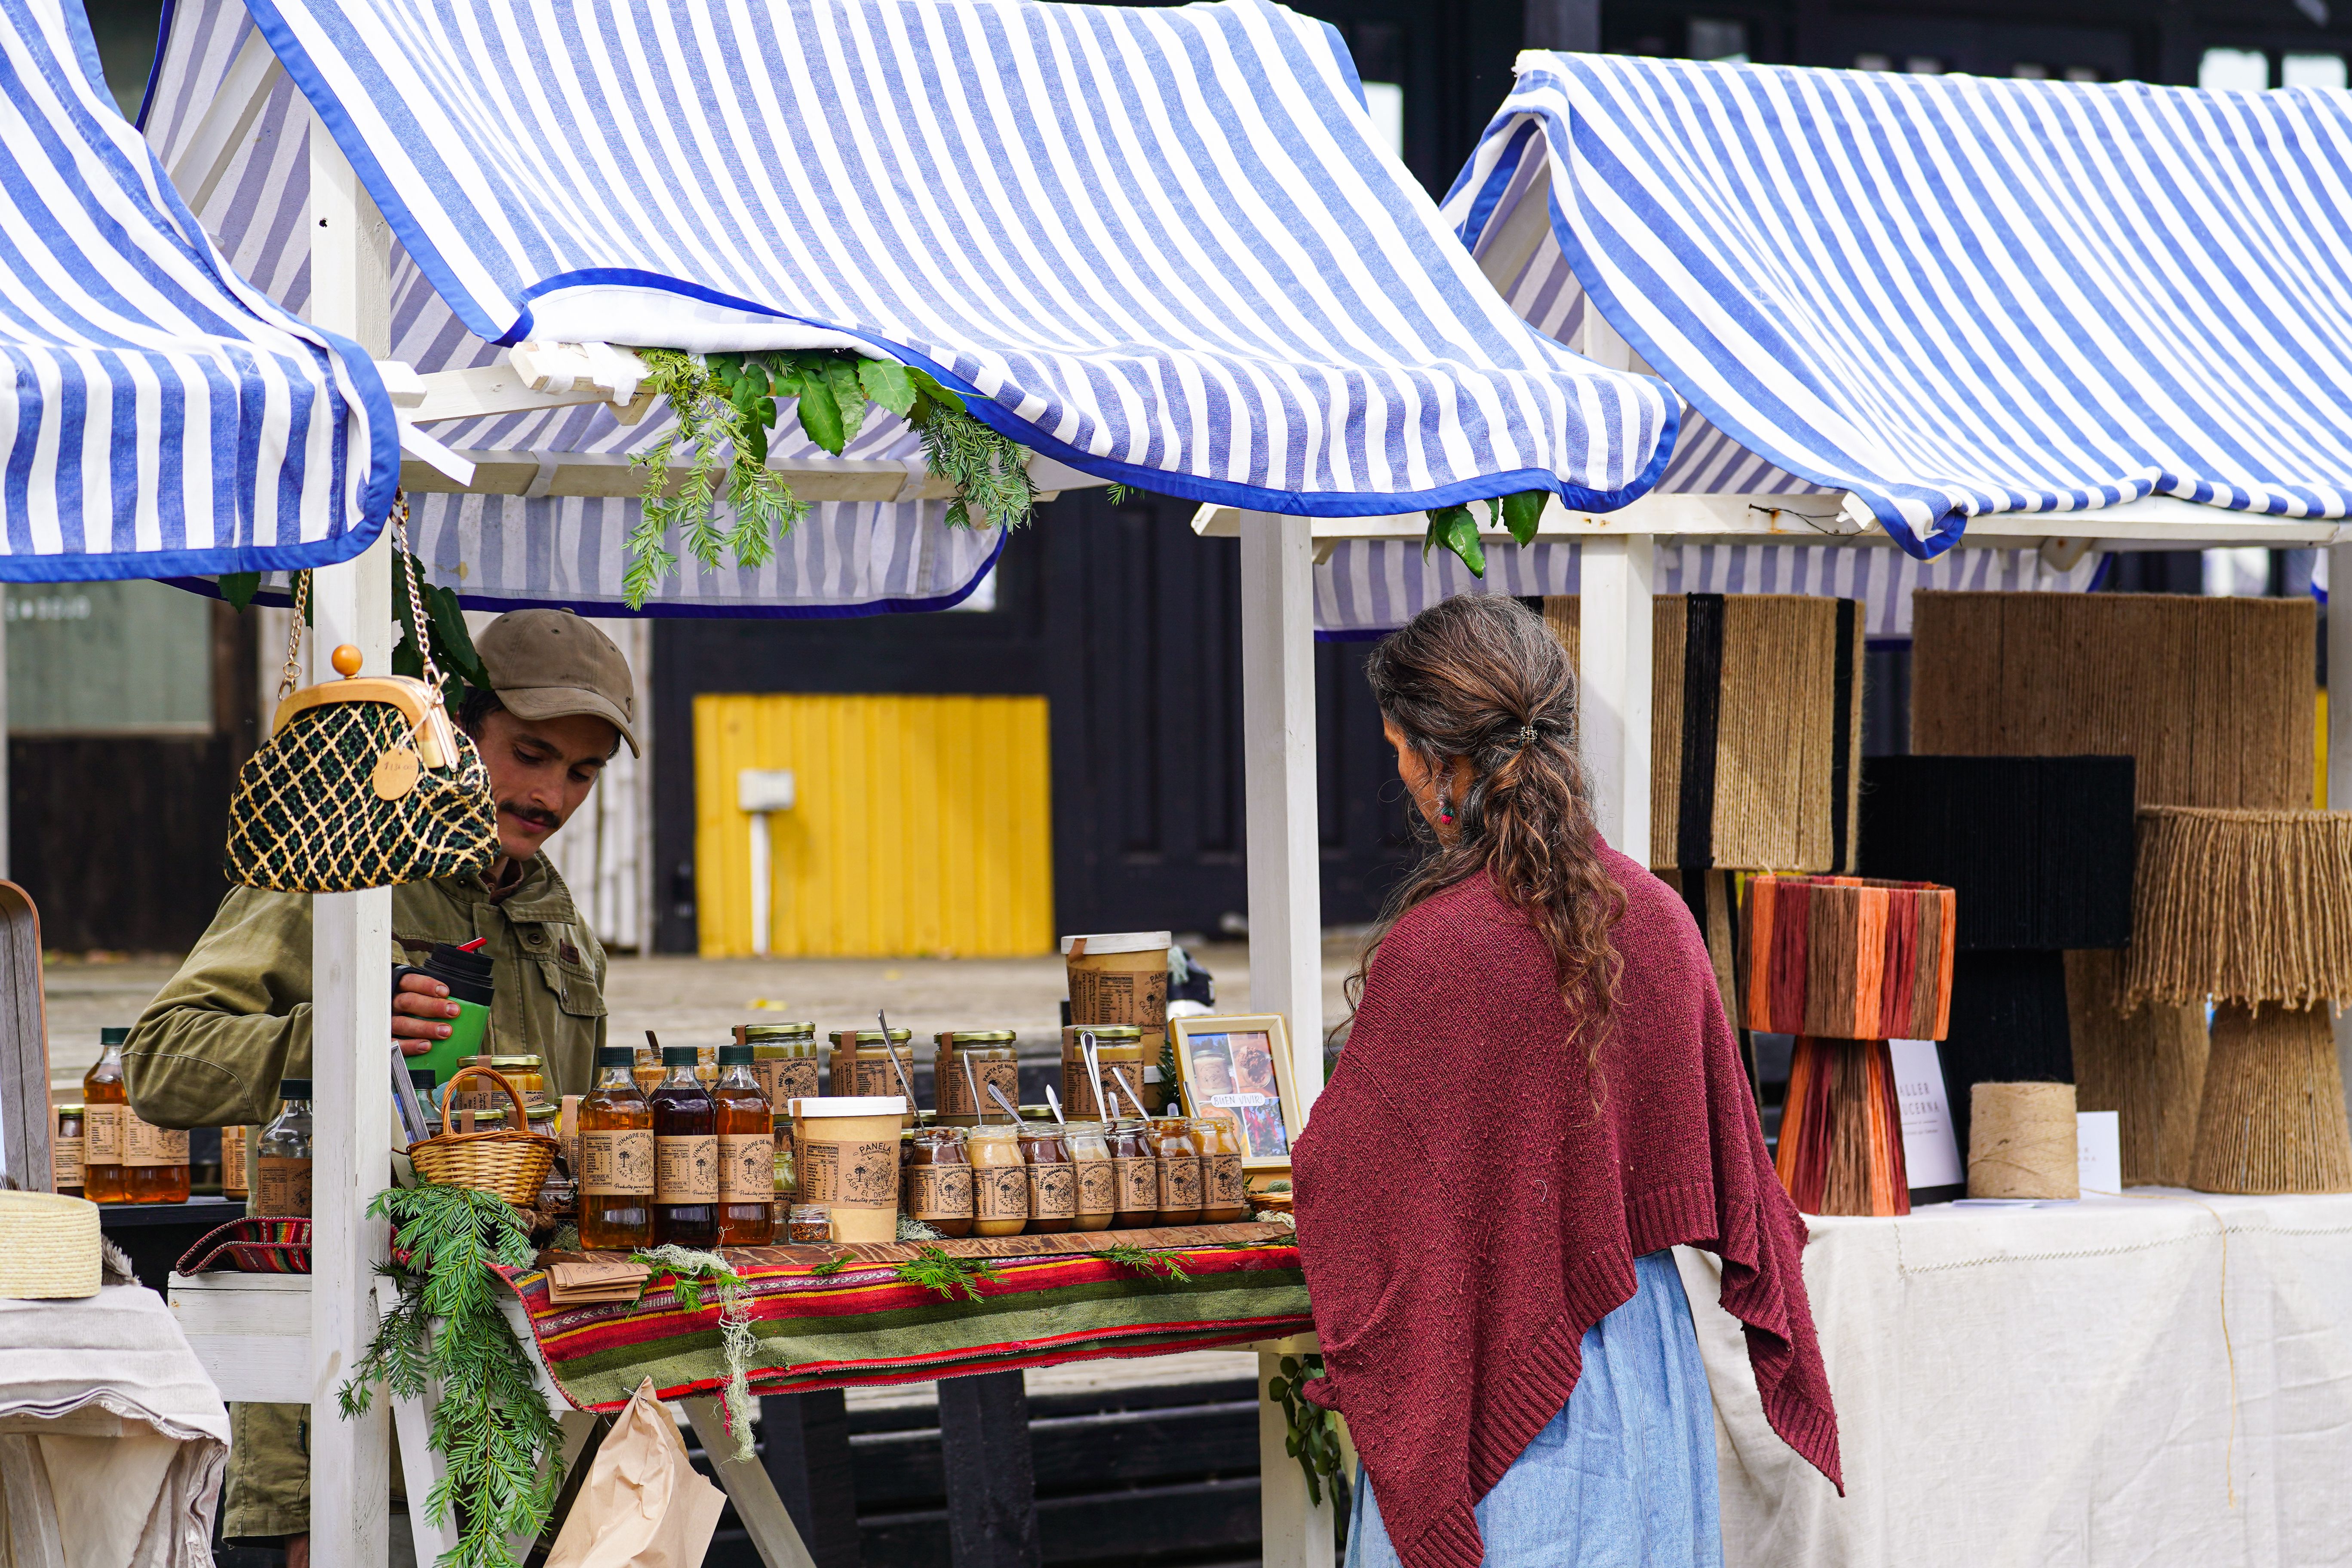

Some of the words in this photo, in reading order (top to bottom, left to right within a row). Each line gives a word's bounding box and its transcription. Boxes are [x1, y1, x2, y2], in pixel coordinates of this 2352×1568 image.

[1150, 972, 1166, 983] PANE
[1139, 1001, 1149, 1017] CASA
[983, 1068, 996, 1082] PASTA
[1900, 1083, 1930, 1096] ALLER
[1214, 1096, 1235, 1105] BUEN
[1238, 1095, 1262, 1105] VIVIR!
[1901, 1101, 1940, 1115] UCERNA
[617, 1132, 639, 1147] VINAGRE
[692, 1139, 710, 1158] VINAGRE
[738, 1140, 758, 1160] VINAGRE
[859, 1142, 891, 1154] PANELA
[617, 1168, 627, 1178] CASA
[945, 1169, 961, 1178] SEMILLA
[1085, 1163, 1105, 1173] MARAVILLA
[1213, 1164, 1222, 1178] PASTA
[290, 1167, 312, 1182] VINAGR
[741, 1174, 752, 1185] CASA
[1130, 1169, 1138, 1181] PASTA
[1170, 1168, 1179, 1181] PASTA
[695, 1175, 704, 1187] CASA
[845, 1174, 859, 1191] CASA
[874, 1172, 897, 1198] DESPERTAR
[995, 1175, 1004, 1187] PASTA
[1083, 1194, 1093, 1202] CASA
[1133, 1191, 1142, 1200] CASA
[1173, 1191, 1182, 1199] CASA
[943, 1199, 952, 1208] CASA
[999, 1198, 1008, 1207] CASA
[1043, 1198, 1053, 1207] CASA
